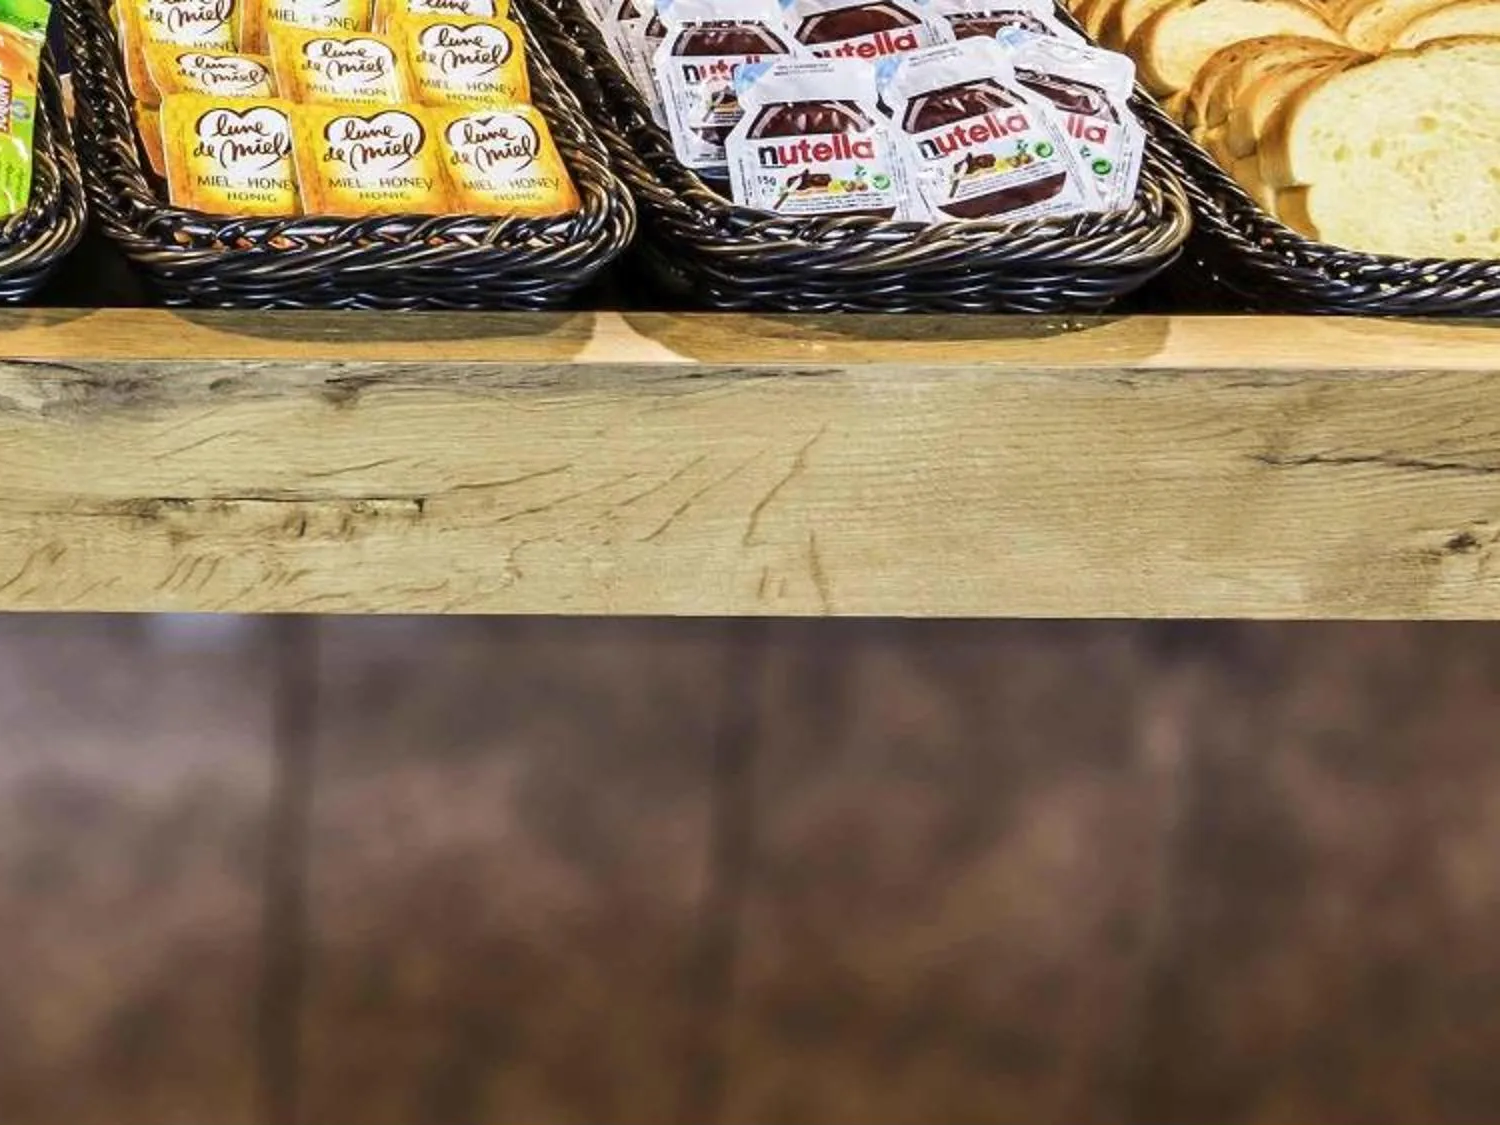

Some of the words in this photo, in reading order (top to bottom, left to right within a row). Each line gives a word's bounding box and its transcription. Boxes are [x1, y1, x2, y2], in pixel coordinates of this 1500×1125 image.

[268, 9, 298, 21] MIEL
[436, 26, 490, 48] lune
[321, 42, 368, 57] lune
[212, 114, 269, 136] lune
[341, 120, 400, 141] lune
[463, 124, 516, 144] lune
[918, 111, 1030, 160] nutella
[194, 141, 216, 158] de
[324, 147, 345, 162] de
[451, 150, 471, 164] de
[758, 134, 875, 167] nutella
[197, 175, 231, 187] MIEL
[329, 178, 362, 189] MIEL
[379, 178, 432, 191] HONEY
[509, 178, 559, 190] HONEY
